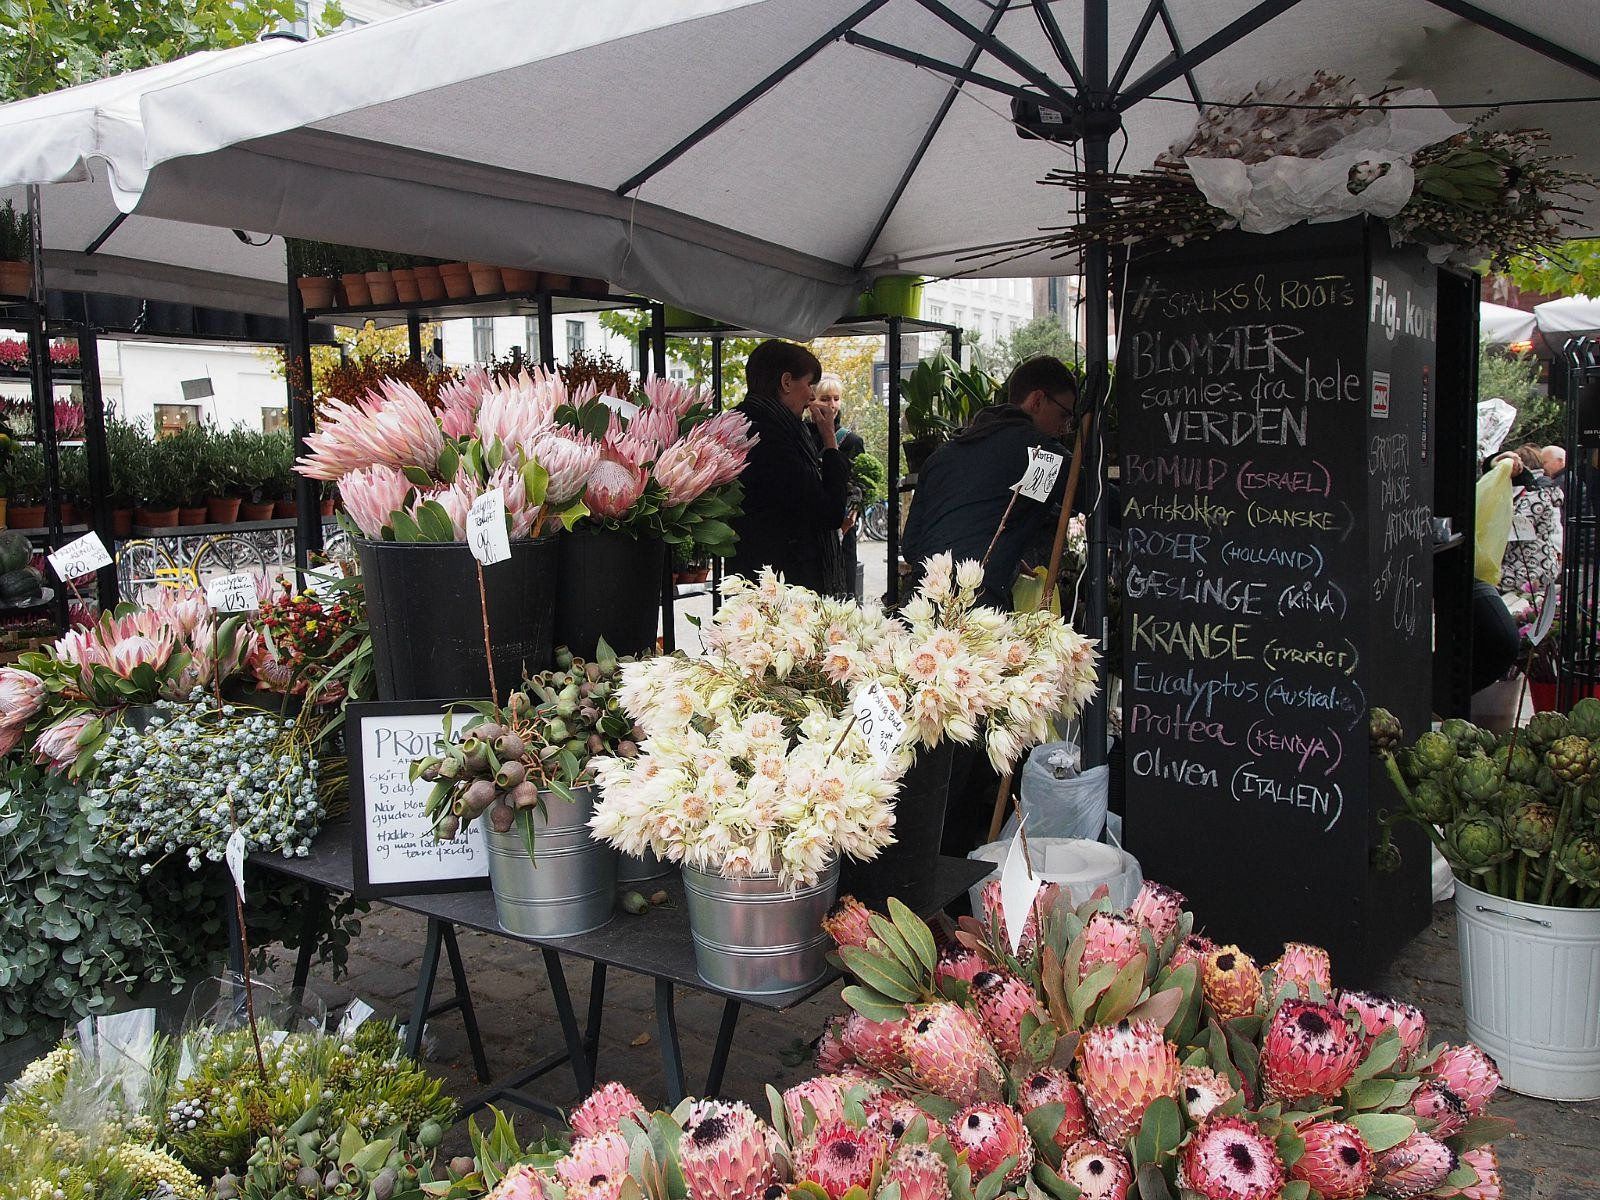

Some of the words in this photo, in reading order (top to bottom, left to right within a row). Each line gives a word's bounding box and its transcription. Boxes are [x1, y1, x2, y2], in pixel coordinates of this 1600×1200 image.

[1254, 274, 1272, 312] &
[1370, 275, 1400, 341] Flg.
[1305, 357, 1361, 402] hele
[1163, 406, 1307, 447] VERDEN
[1237, 460, 1331, 500] (ISRAEL)
[1127, 527, 1210, 564] ROSER
[1222, 541, 1324, 577] (HOLLAND)
[1132, 613, 1254, 661] KRANSE
[1134, 662, 1259, 721] Eucalyptus
[1131, 704, 1236, 745] Protea
[1133, 748, 1218, 787] Oliven
[1231, 761, 1343, 832] (ITALIEN)
[377, 845, 390, 859] og
